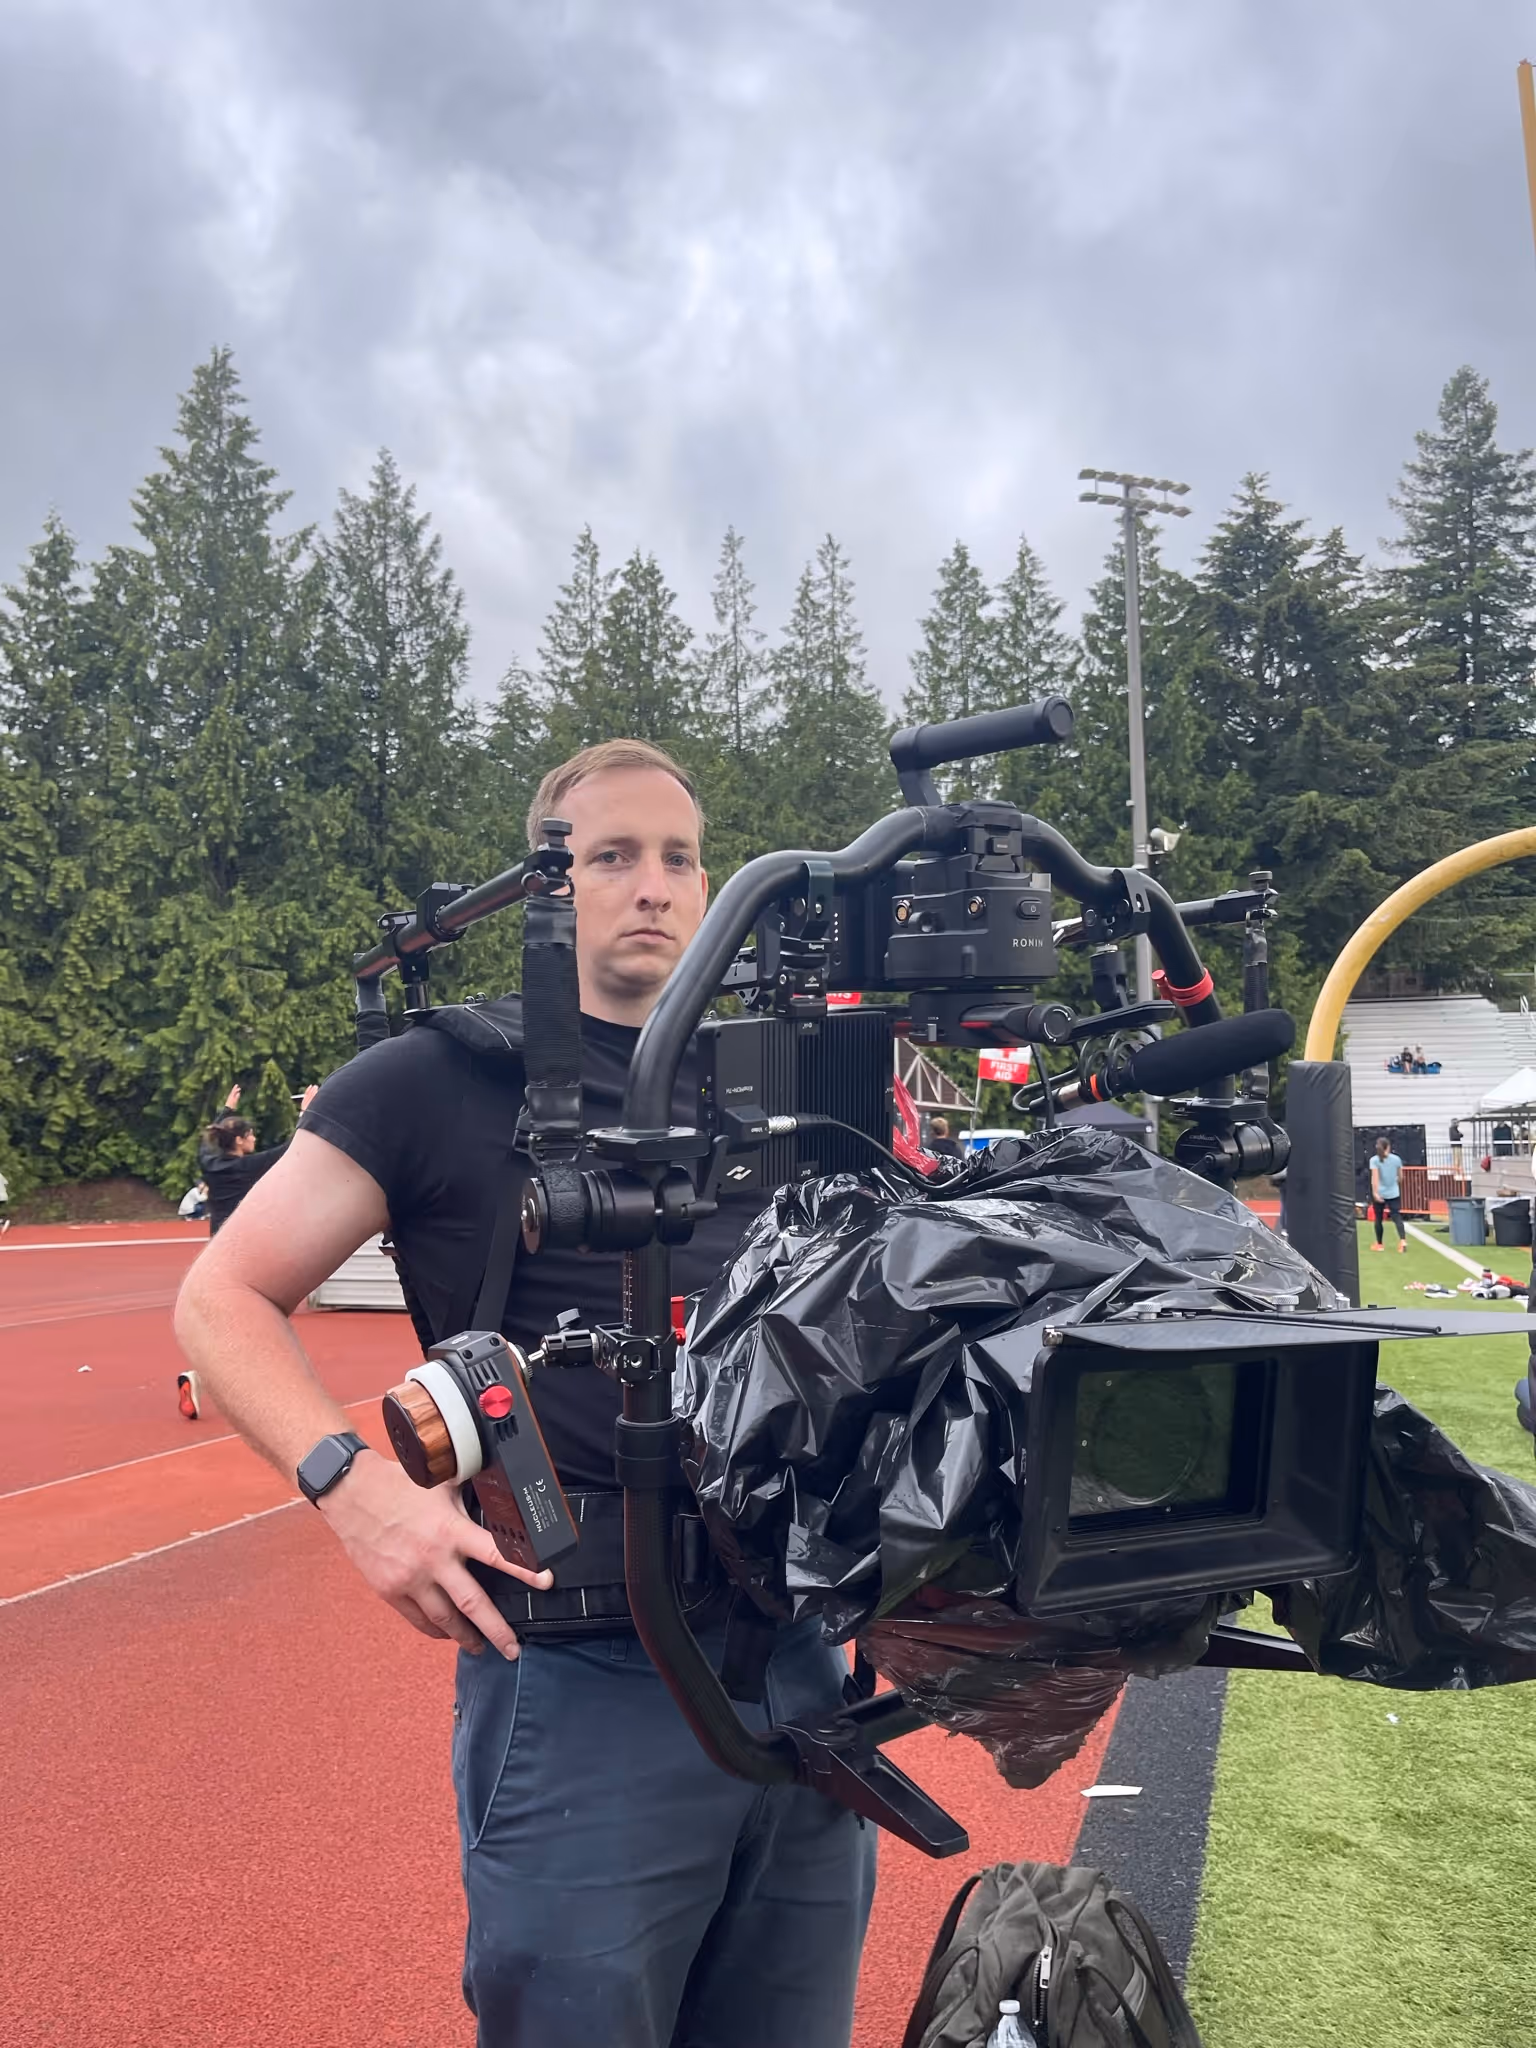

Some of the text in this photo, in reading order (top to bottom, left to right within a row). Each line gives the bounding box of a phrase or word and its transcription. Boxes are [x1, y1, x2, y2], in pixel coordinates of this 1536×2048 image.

[1012, 938, 1044, 948] RONIN
[990, 1060, 1019, 1073] FIRST
[993, 1070, 1013, 1081] AID
[522, 1486, 543, 1533] NUCLEUS-M
